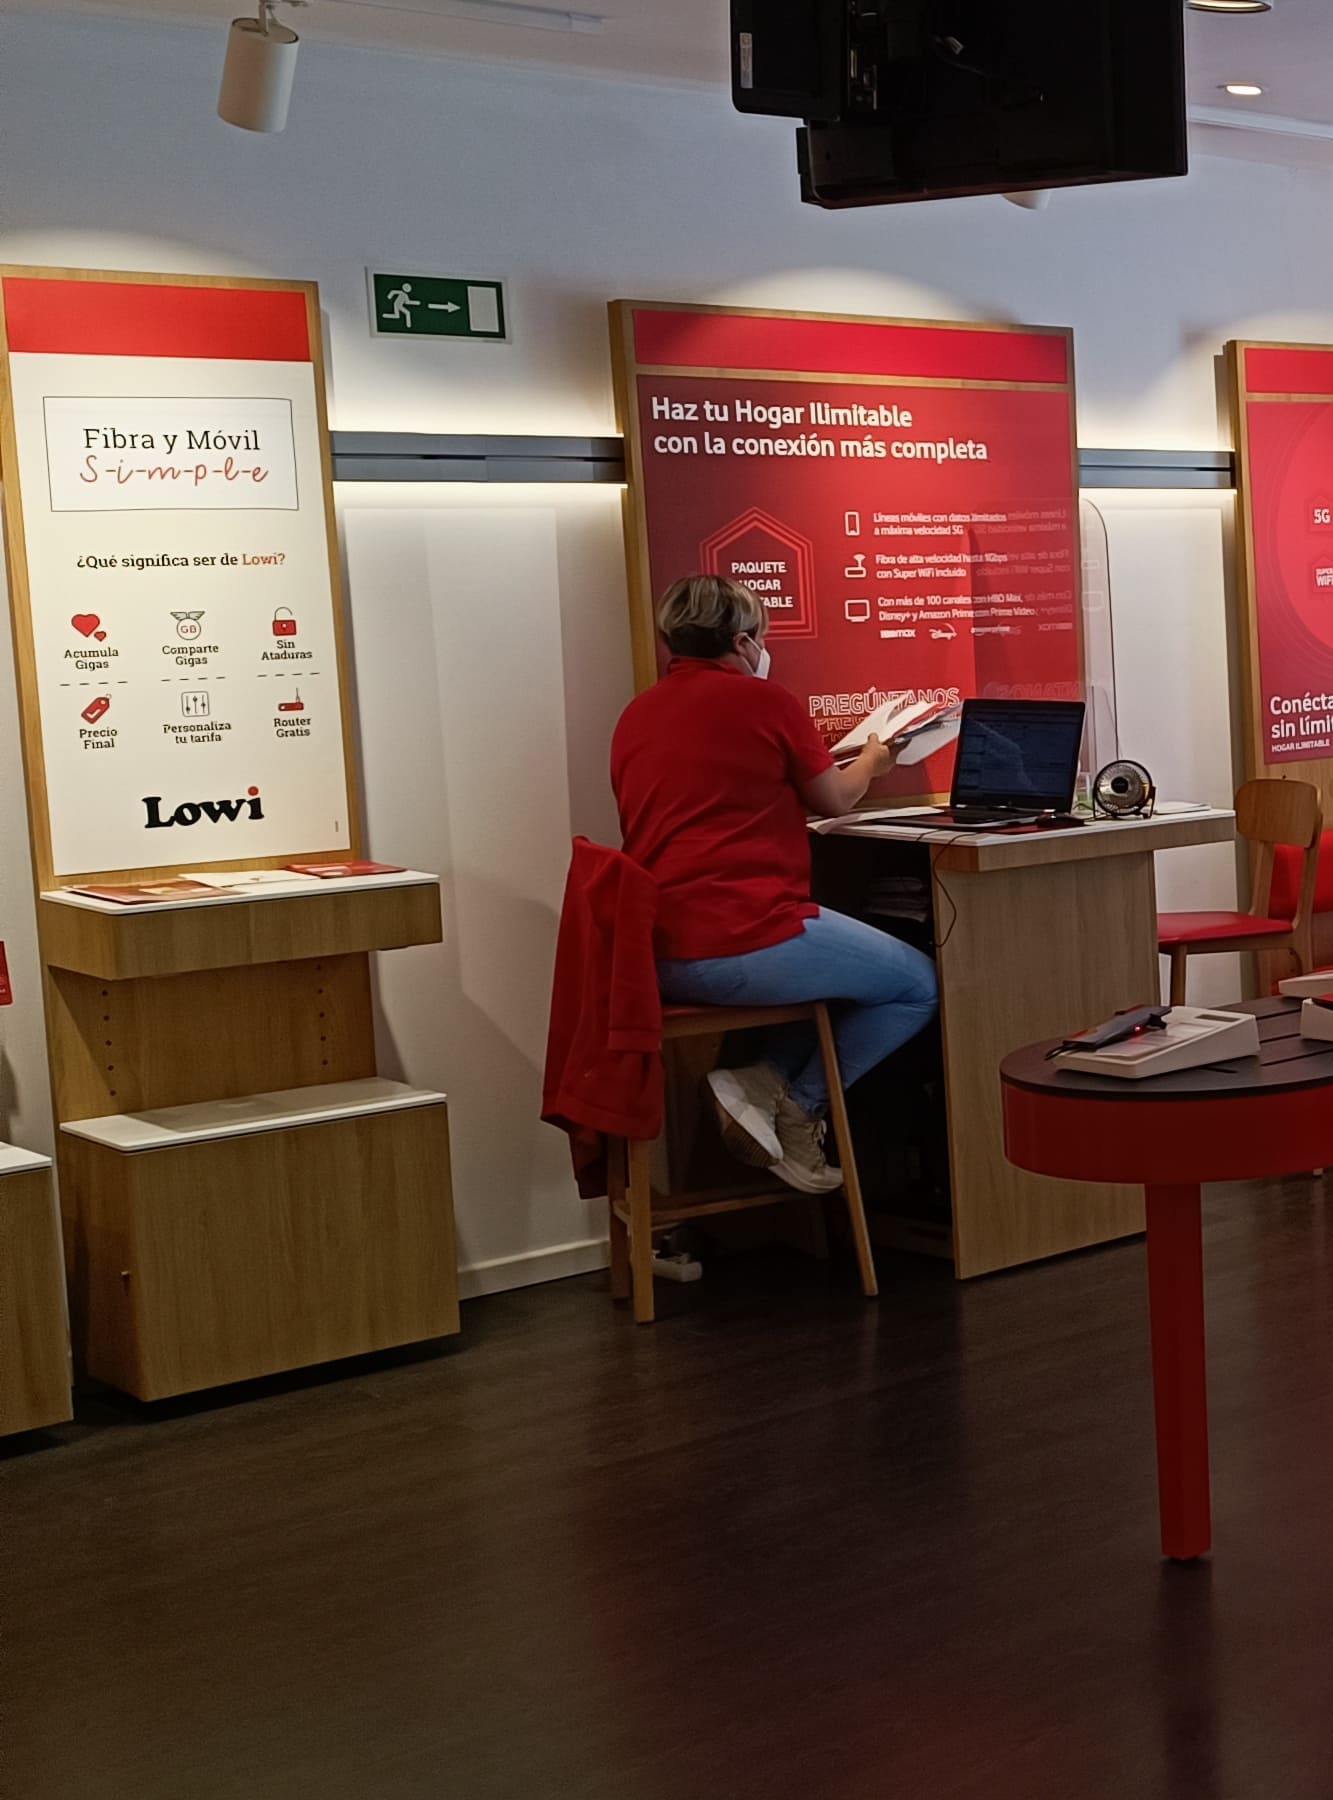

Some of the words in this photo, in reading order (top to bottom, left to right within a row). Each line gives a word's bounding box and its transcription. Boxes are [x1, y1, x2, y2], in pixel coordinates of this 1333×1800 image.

[652, 396, 699, 421] Haz
[704, 400, 729, 422] tu
[735, 399, 804, 429] Hogar
[809, 402, 912, 427] Ilimitable
[83, 427, 155, 449] Fibra
[163, 434, 178, 455] y
[186, 429, 261, 451] Móvil
[654, 434, 698, 454] con
[704, 432, 726, 455] la
[732, 433, 835, 457] conexión
[840, 435, 887, 458] más
[891, 437, 988, 464] completa
[901, 513, 931, 522] móviles
[933, 514, 947, 522] con
[1314, 508, 1331, 524] 5G
[881, 525, 912, 535] máxima
[914, 524, 950, 535] velocidad
[951, 525, 963, 535] 5G
[77, 555, 117, 569] ¿Qué
[122, 553, 189, 570] significa
[193, 556, 216, 566] ser
[220, 553, 238, 566] de
[242, 552, 285, 566] Lowi?
[876, 554, 896, 564] Fibra
[897, 554, 908, 563] de
[925, 553, 961, 564] velocidad
[731, 562, 787, 574] PAQUETE
[877, 570, 892, 578] con
[893, 569, 917, 580] Super
[935, 568, 966, 577] incluido
[878, 597, 895, 606] Con
[896, 596, 912, 606] más
[913, 597, 925, 605] de
[926, 595, 941, 605] 100
[180, 625, 197, 634] GB
[276, 639, 295, 649] Sin
[64, 647, 119, 659] Acumula
[162, 644, 219, 657] Comparte
[261, 650, 312, 661] Ataduras
[75, 660, 109, 672] Gigas
[175, 656, 208, 668] Gigas
[162, 721, 232, 734] Personaliza
[273, 717, 312, 728] Router
[79, 727, 118, 738] Precio
[276, 727, 310, 738] Gratis
[1271, 719, 1296, 739] sin
[84, 738, 115, 749] Final
[175, 734, 187, 744] tu
[190, 732, 222, 743] tarifa
[1271, 742, 1295, 752] HOGAR
[142, 786, 264, 828] Lowi
